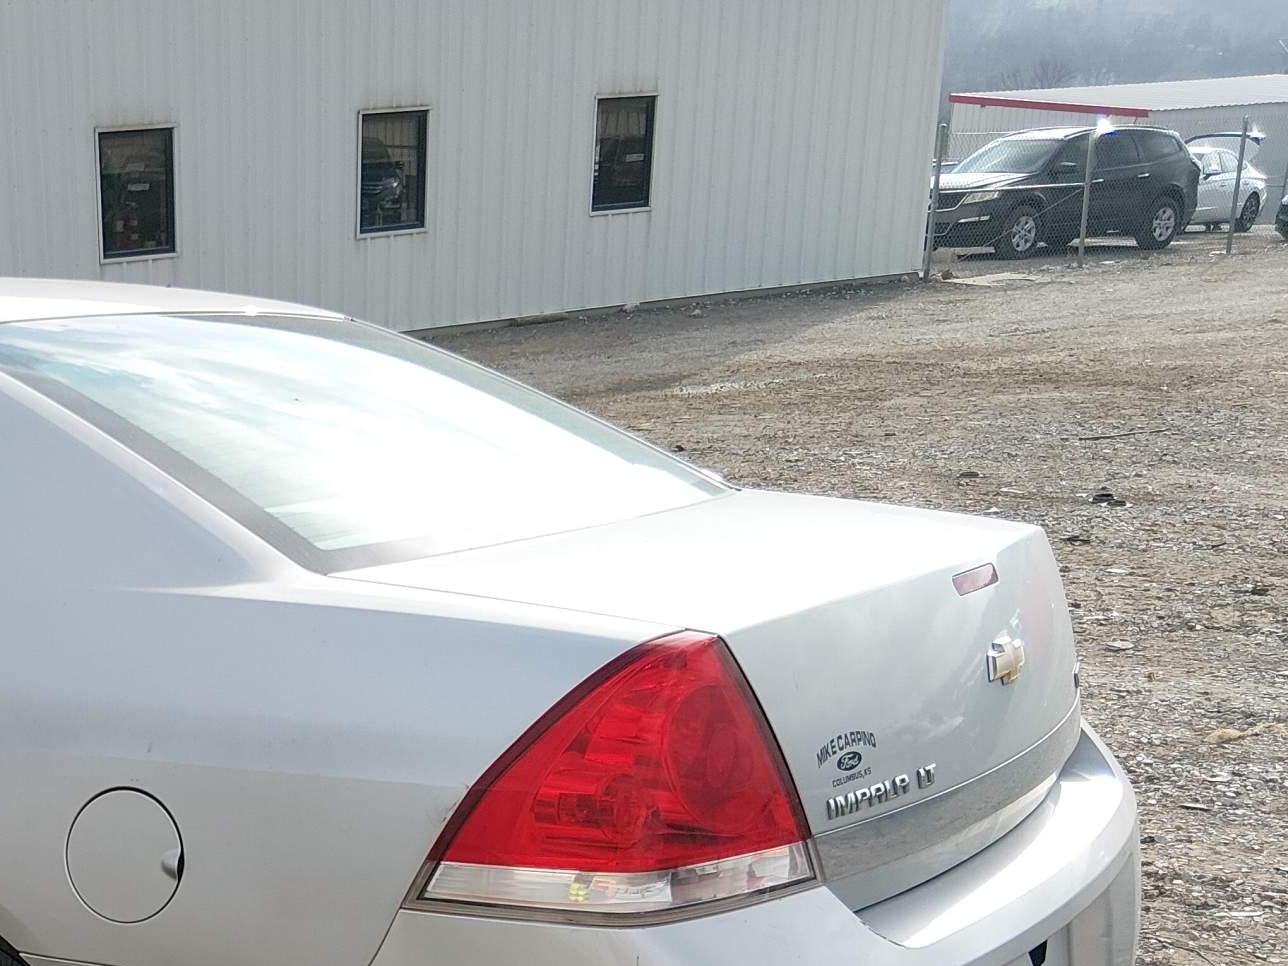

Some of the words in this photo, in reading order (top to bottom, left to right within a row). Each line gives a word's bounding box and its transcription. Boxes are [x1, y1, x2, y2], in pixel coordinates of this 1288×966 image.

[817, 738, 837, 768] MIKE
[836, 730, 877, 752] CARPINO
[826, 774, 910, 820] IMPALA
[916, 763, 937, 789] LT
